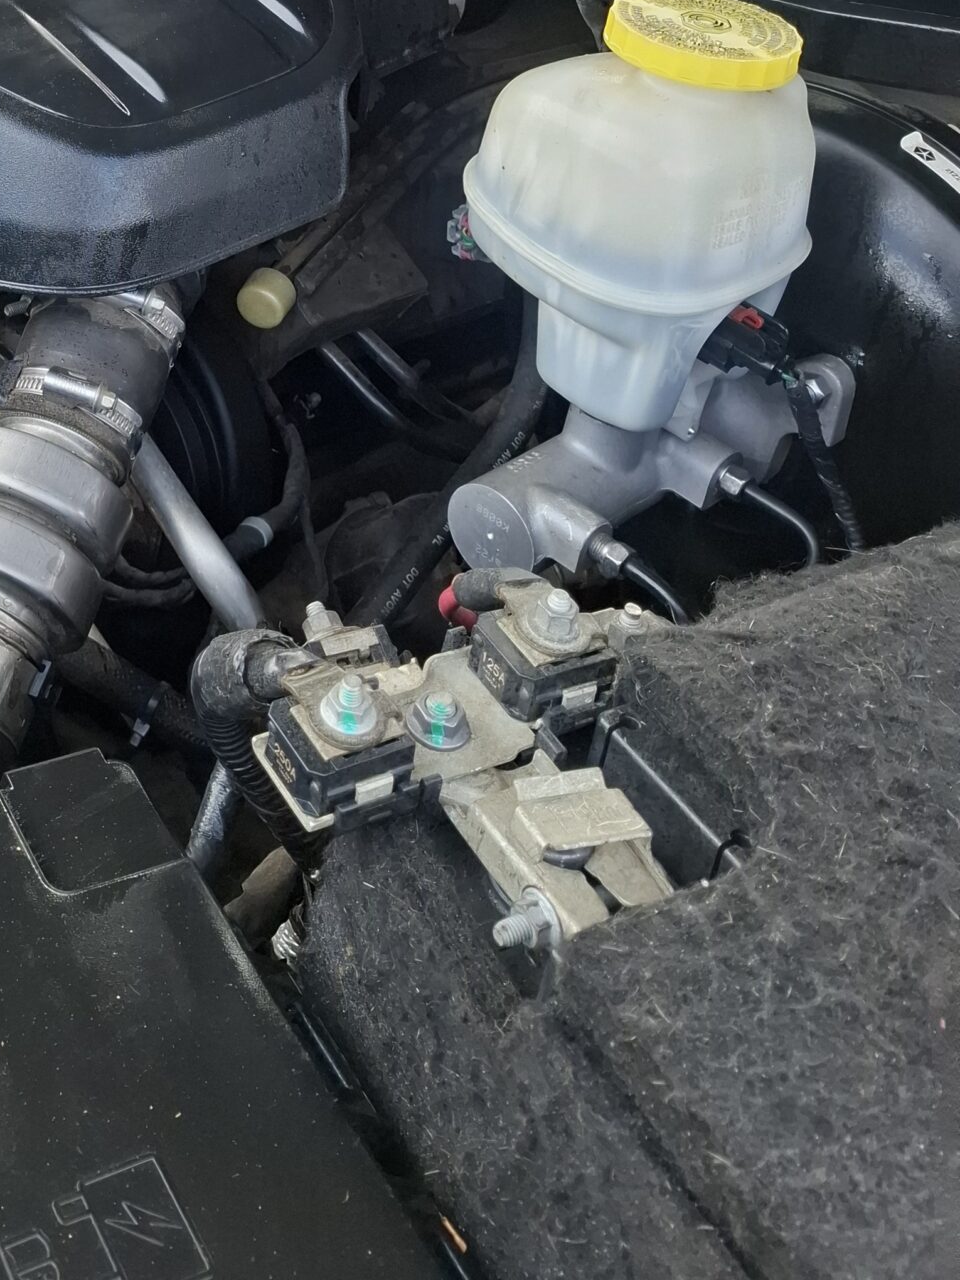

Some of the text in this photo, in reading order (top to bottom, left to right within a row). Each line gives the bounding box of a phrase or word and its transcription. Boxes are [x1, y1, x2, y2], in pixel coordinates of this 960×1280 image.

[402, 567, 420, 590] DOT
[482, 651, 505, 686] 125A
[274, 742, 296, 782] 250A
